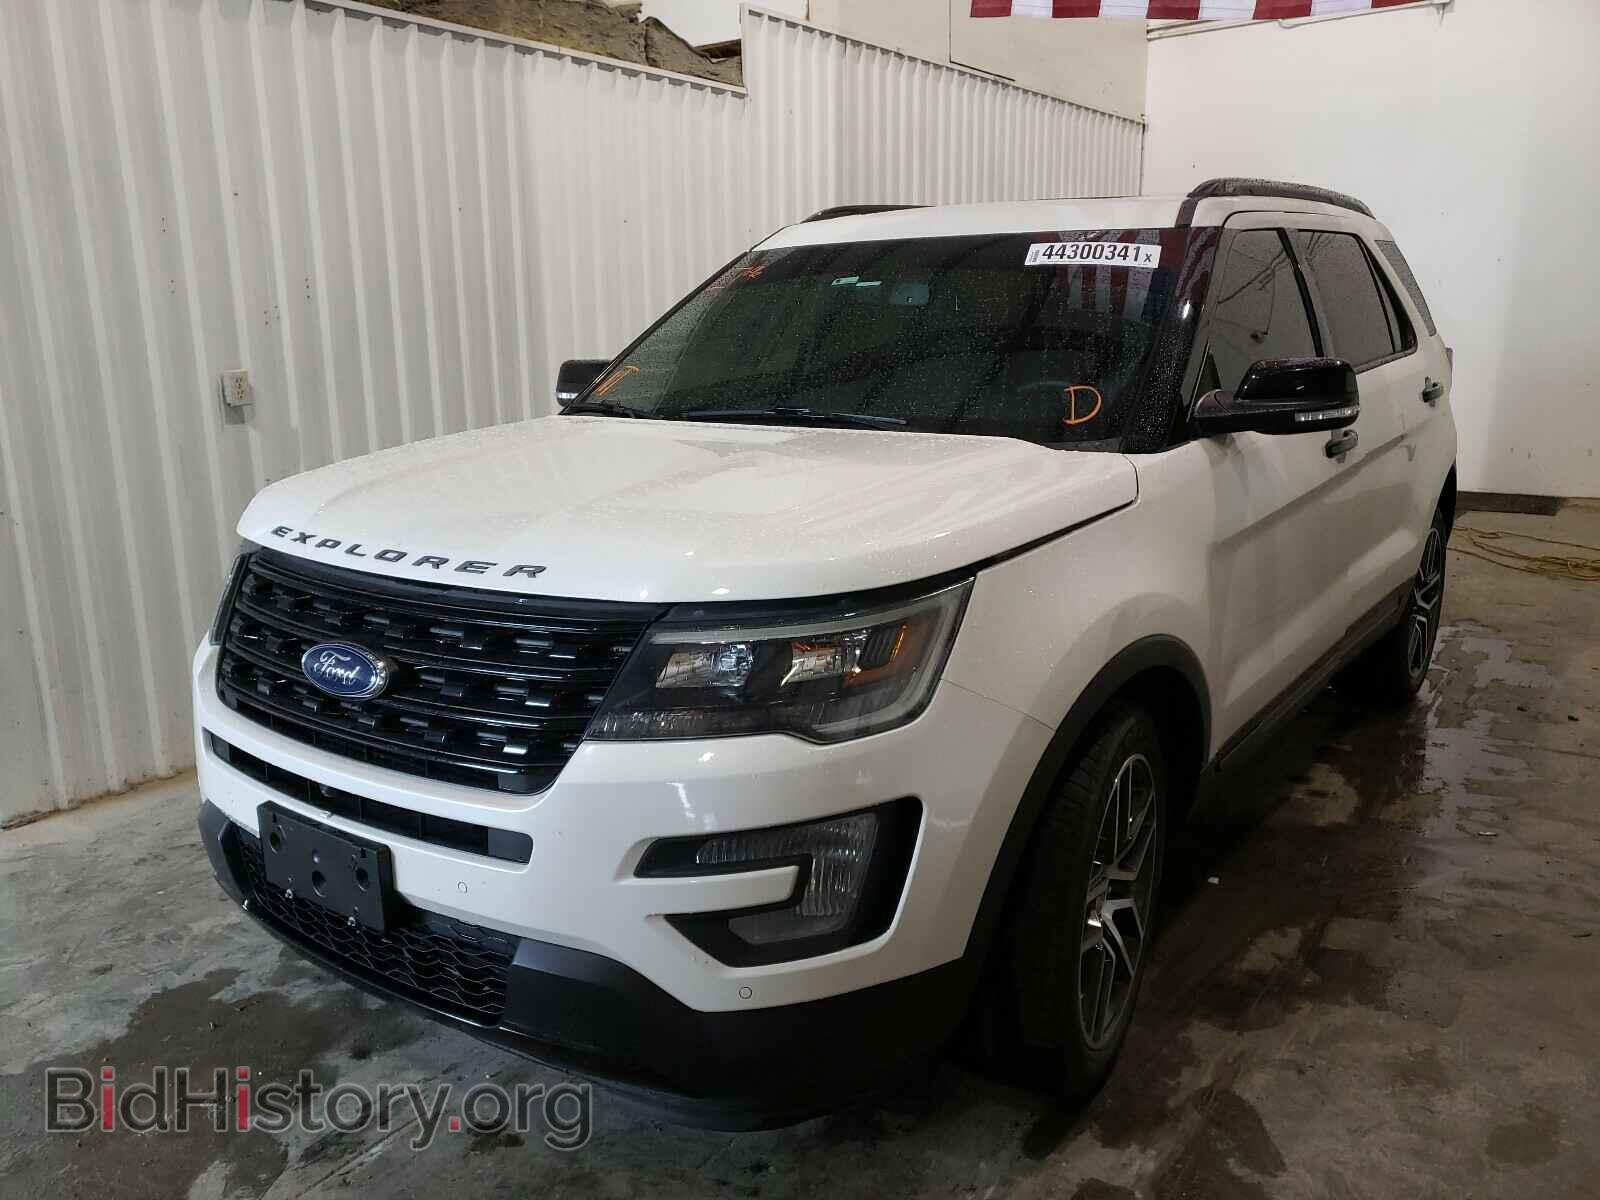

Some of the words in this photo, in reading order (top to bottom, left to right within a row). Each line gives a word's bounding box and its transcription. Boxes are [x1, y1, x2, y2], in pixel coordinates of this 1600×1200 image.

[1042, 243, 1141, 262] 44300341
[1062, 385, 1102, 425] D
[270, 524, 548, 579] EXPLORER
[313, 650, 361, 687] Ford
